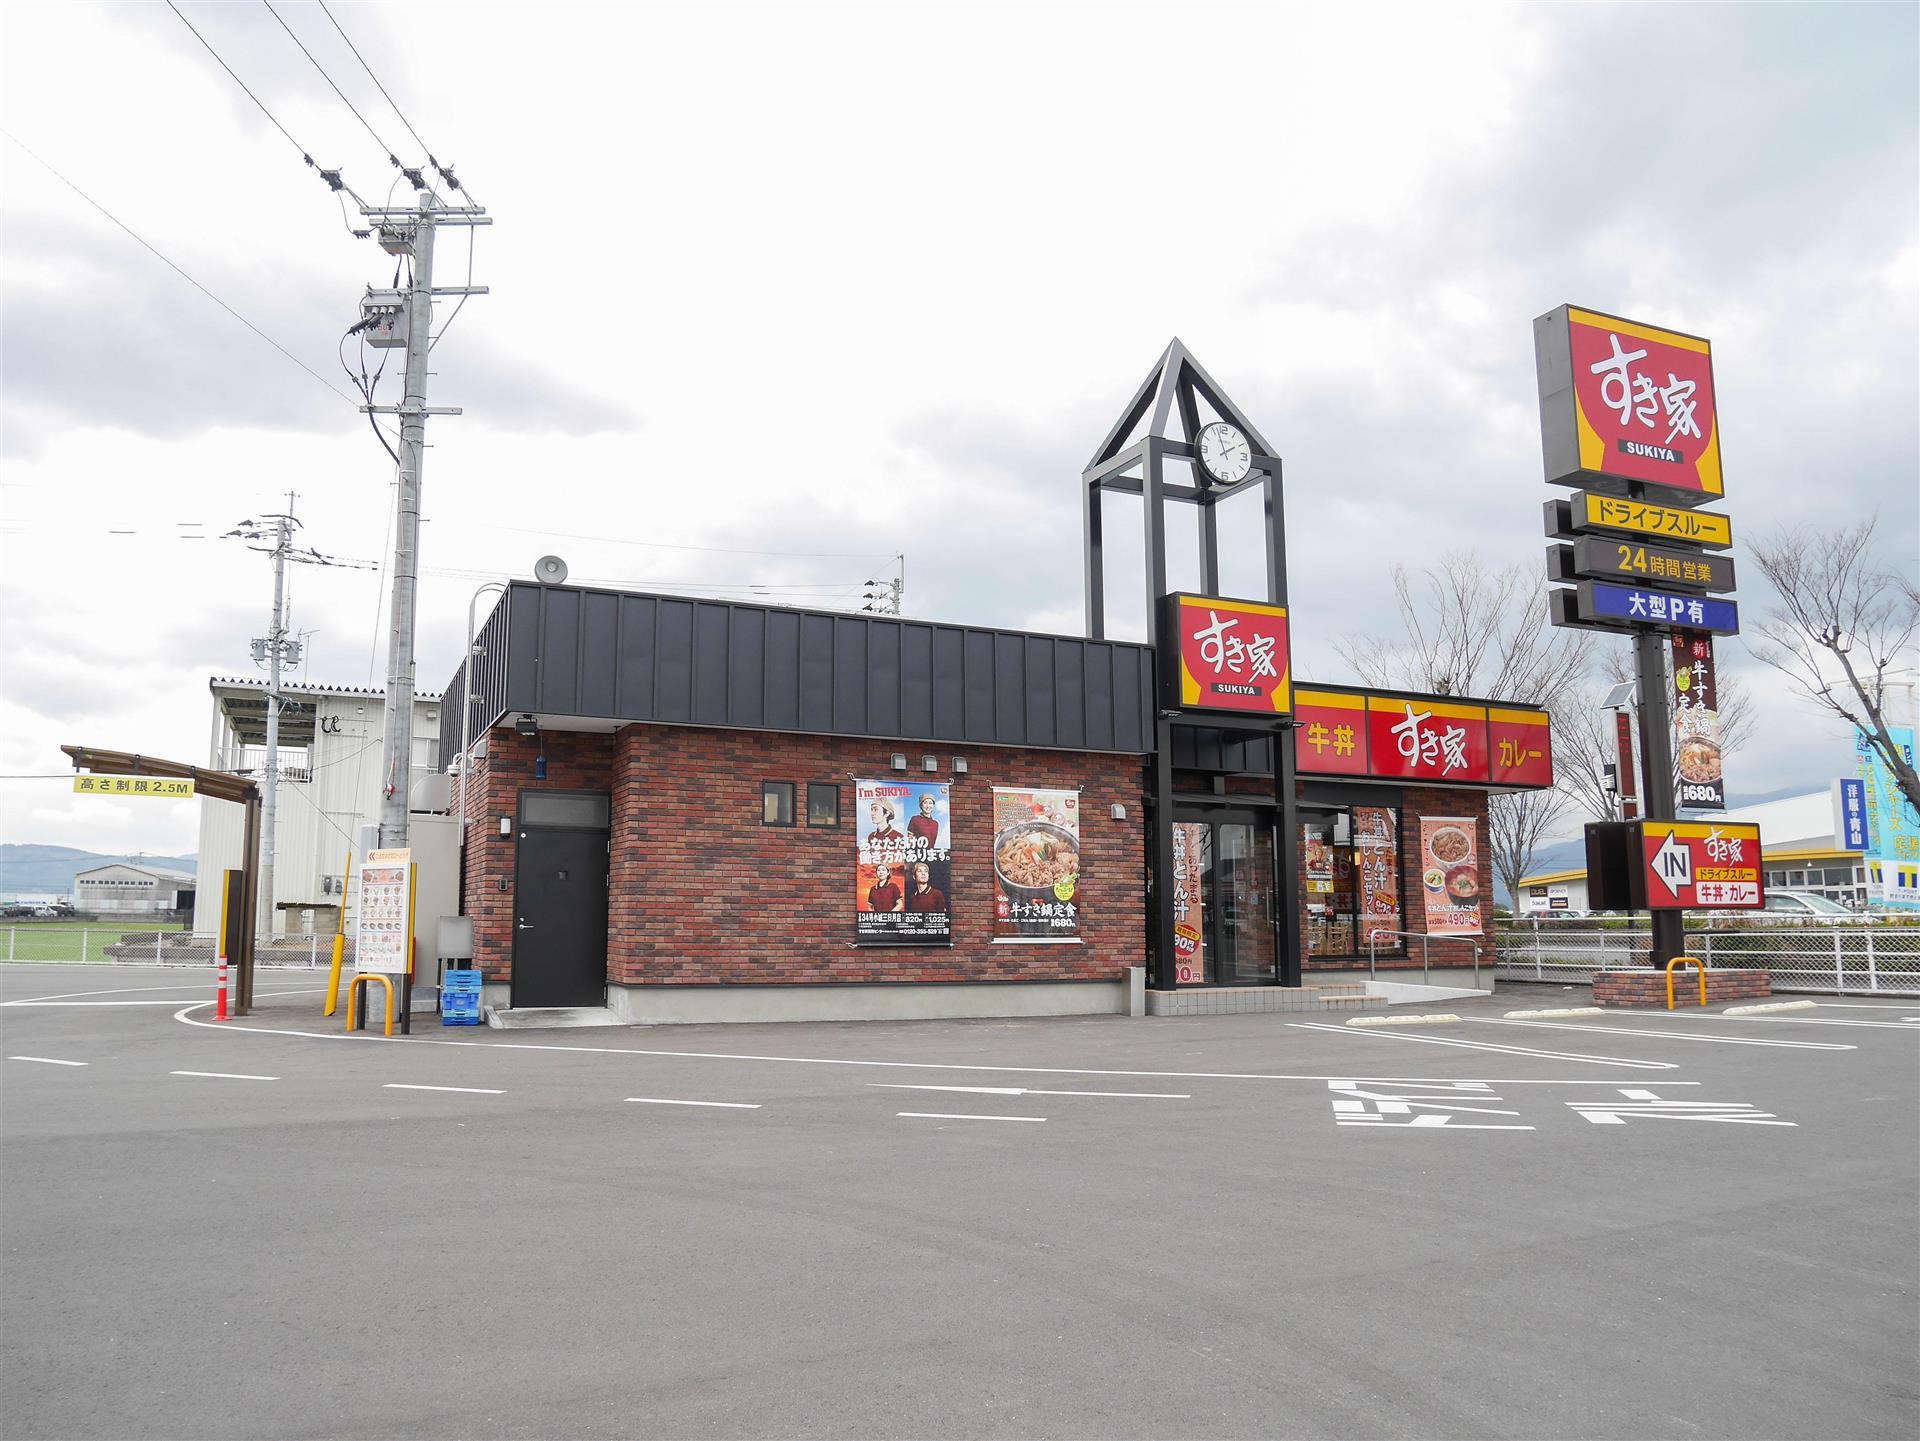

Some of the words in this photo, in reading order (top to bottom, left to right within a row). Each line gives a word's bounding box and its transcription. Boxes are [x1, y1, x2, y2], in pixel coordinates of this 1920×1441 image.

[1590, 332, 1702, 445] すき家
[1626, 440, 1675, 462] SUKIYA
[1598, 499, 1717, 537] ドライブスルー
[1617, 544, 1712, 583] 24時間営業
[1628, 591, 1704, 625] 大型P有
[1193, 610, 1277, 684] すき家
[1217, 683, 1255, 695] SUKIYA
[1692, 660, 1710, 736] 牛すき鍋
[1678, 693, 1692, 735] 定食
[1307, 722, 1356, 758] 牛丼
[1391, 703, 1468, 777] すき家
[1498, 737, 1542, 769] カレー
[1847, 784, 1862, 845] 洋服の青山
[859, 836, 929, 851] あなただけの
[1704, 826, 1743, 867] すき家
[1663, 852, 1687, 877] IN
[1700, 868, 1753, 880] ドライブスルー
[1010, 902, 1077, 917] 牛すき鍋定食
[1701, 884, 1756, 902] 牛丼・カレー
